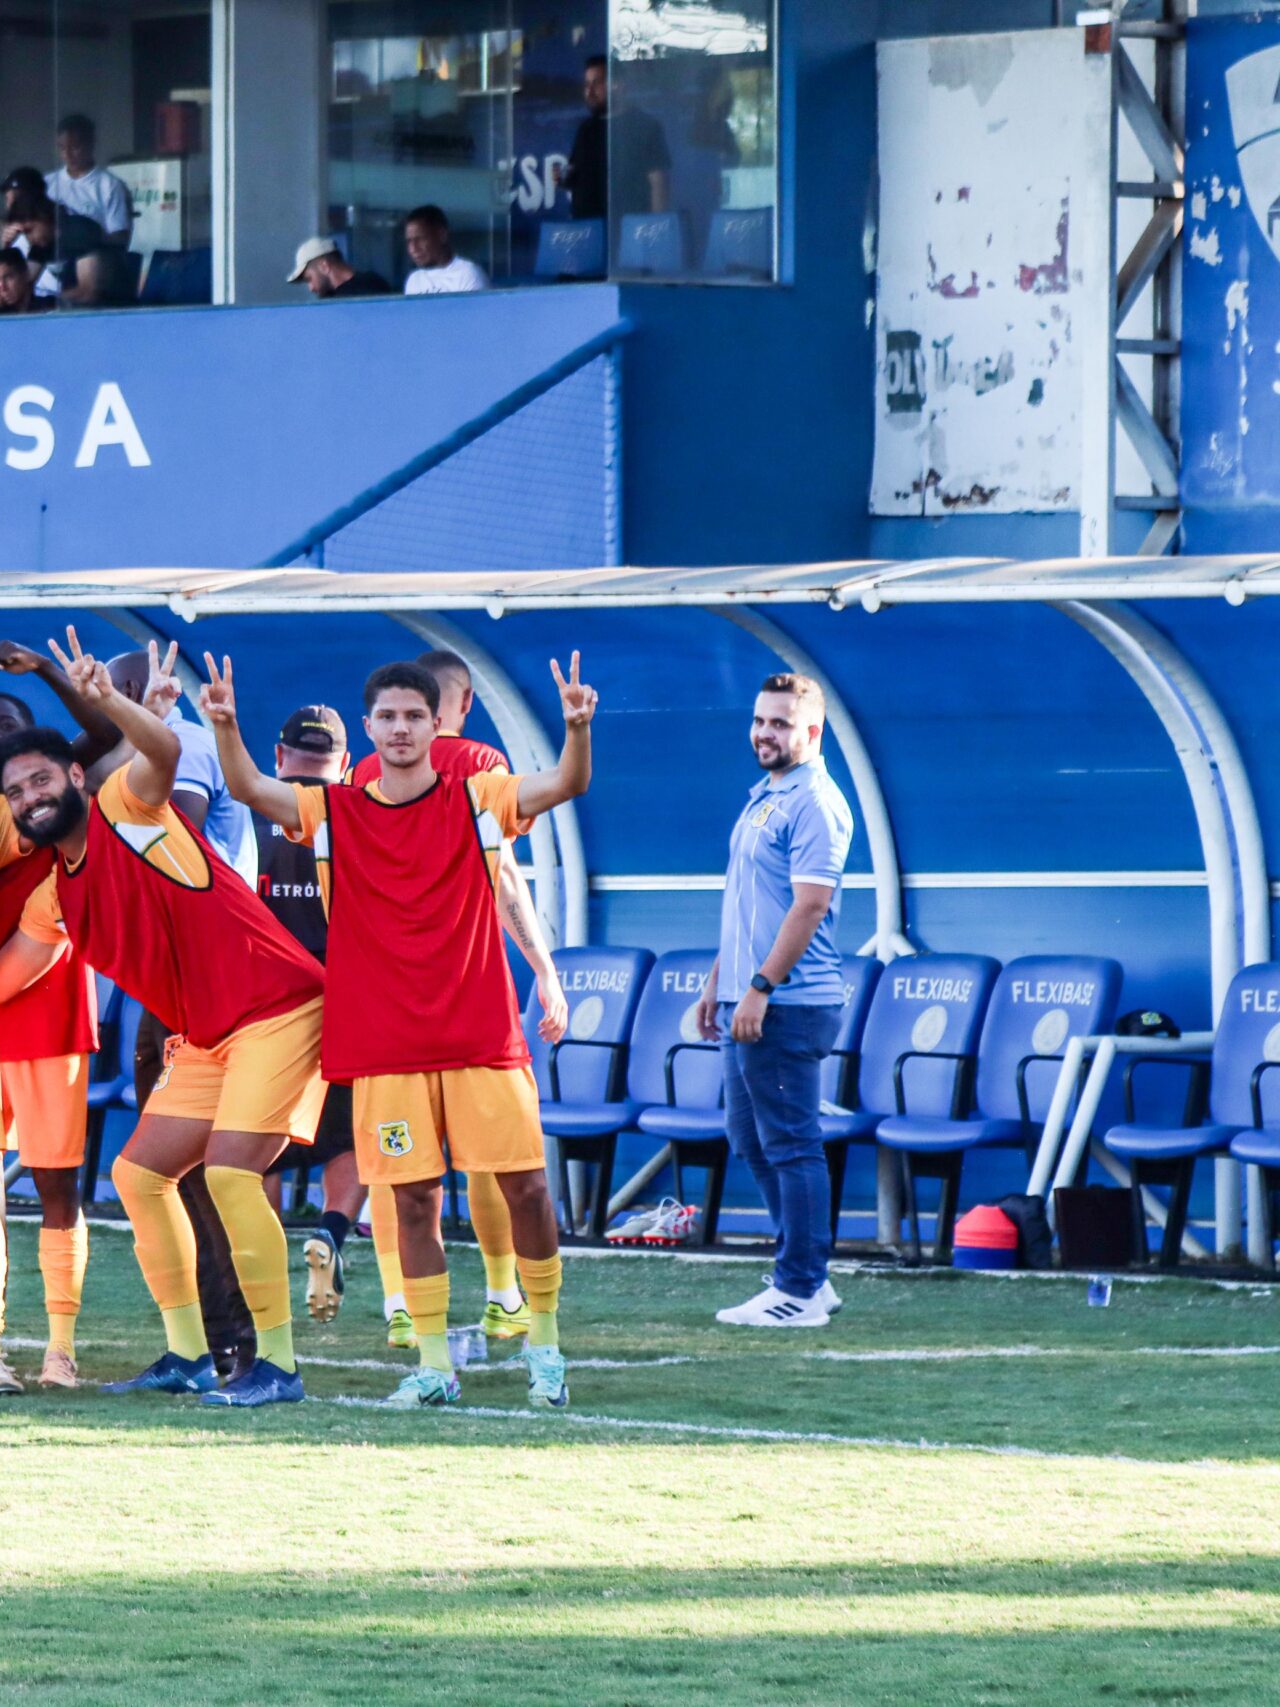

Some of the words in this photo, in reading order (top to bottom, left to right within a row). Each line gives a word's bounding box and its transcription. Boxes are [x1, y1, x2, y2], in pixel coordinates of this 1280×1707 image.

[557, 969, 630, 994] LEXIBASE
[893, 977, 974, 1003] FLEXIBASE
[1011, 981, 1095, 1006] FLEXIBASE
[1241, 989, 1280, 1013] FLE
